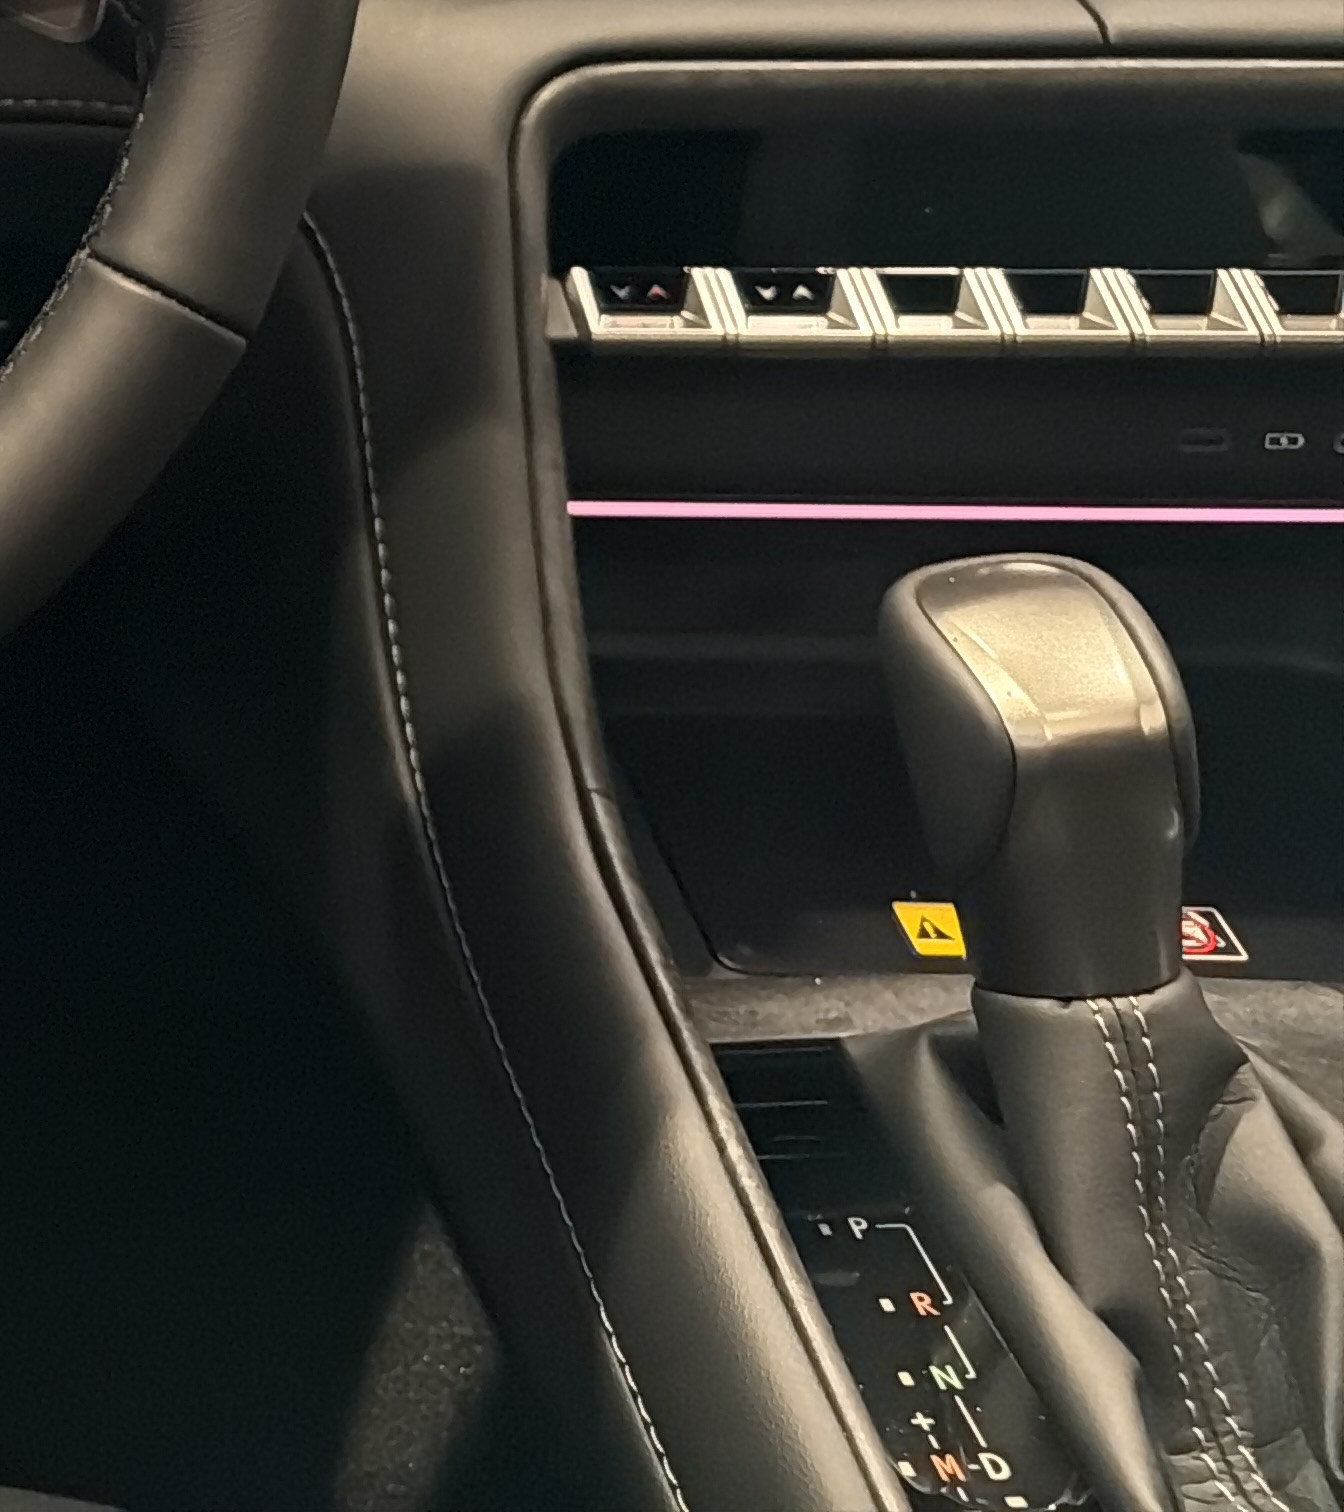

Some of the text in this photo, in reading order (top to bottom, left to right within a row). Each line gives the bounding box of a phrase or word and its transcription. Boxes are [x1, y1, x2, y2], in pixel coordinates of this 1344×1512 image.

[847, 1216, 868, 1239] P
[910, 1292, 941, 1316] R
[928, 1365, 964, 1390] N
[930, 1453, 1011, 1482] M D
